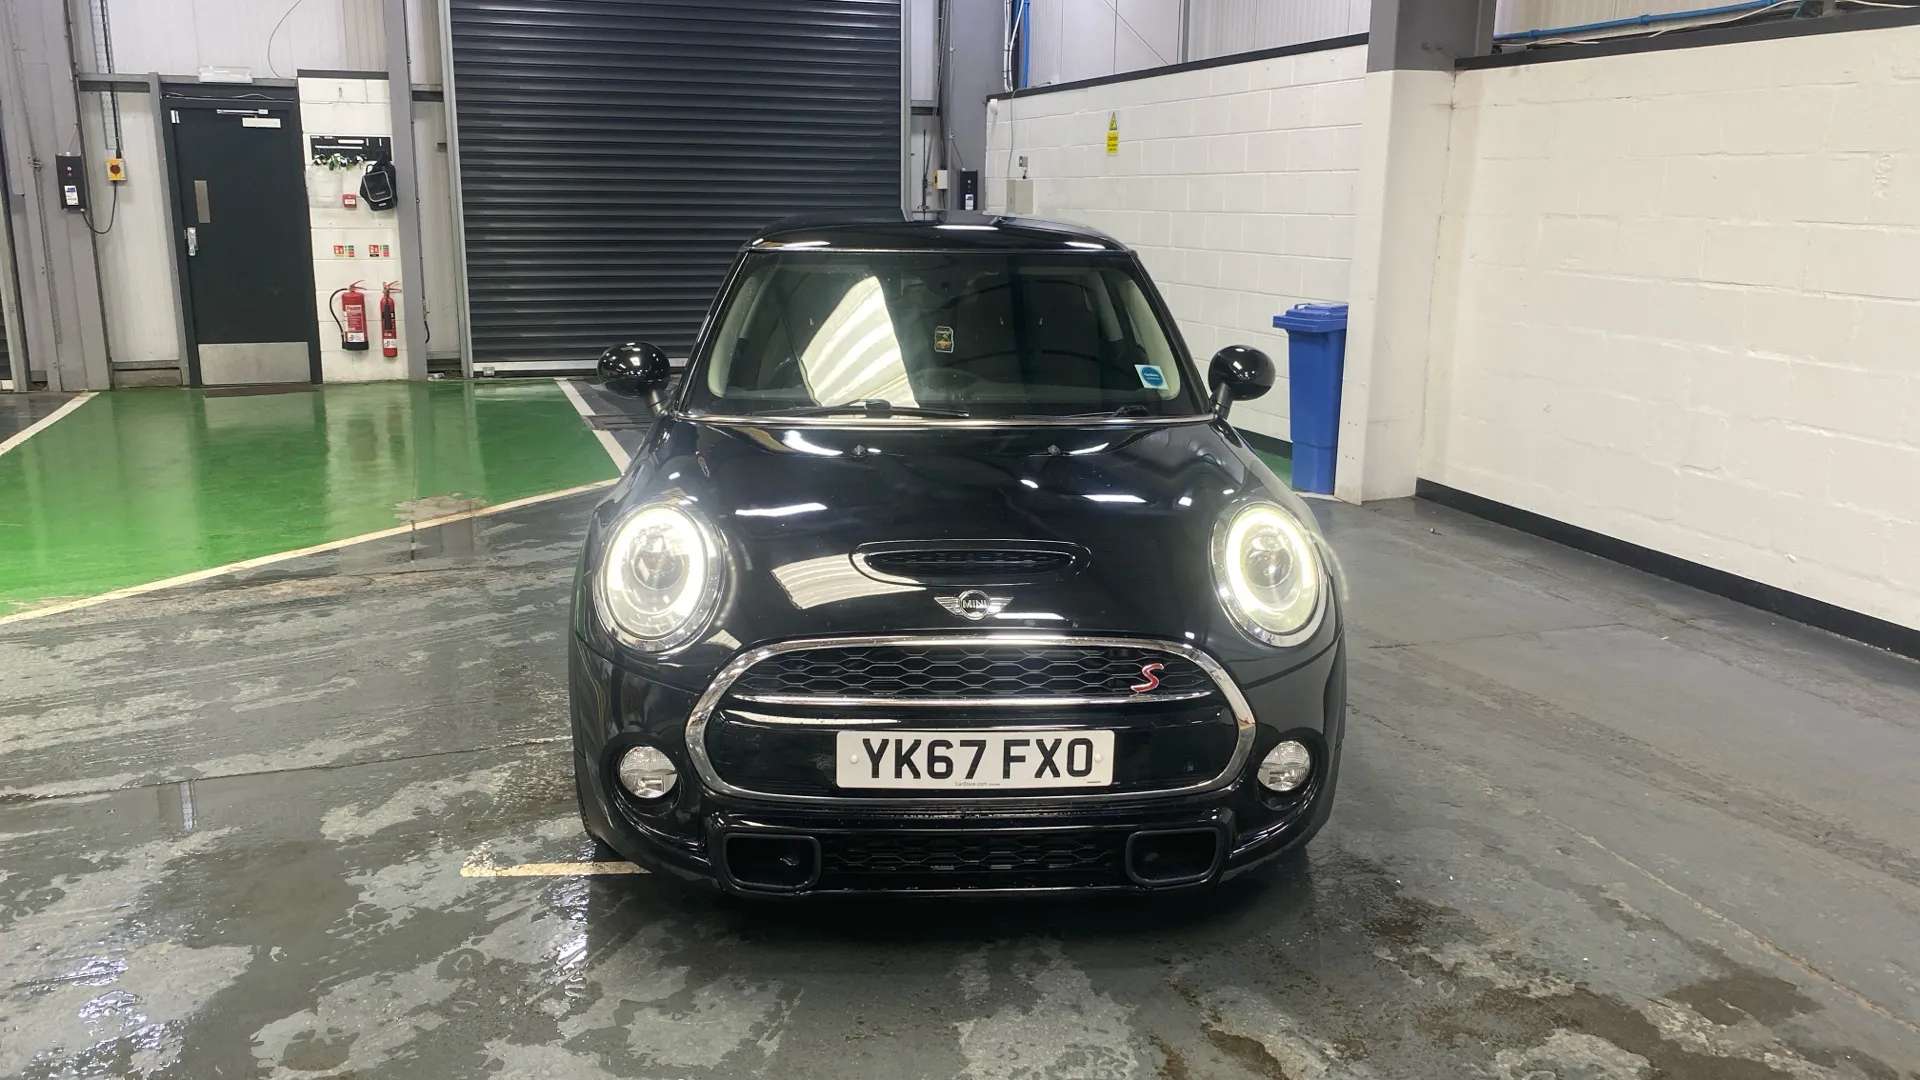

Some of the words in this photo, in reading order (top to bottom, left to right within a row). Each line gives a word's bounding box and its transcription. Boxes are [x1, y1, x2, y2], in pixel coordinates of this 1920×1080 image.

[962, 599, 988, 609] MINI
[1130, 662, 1165, 693] S
[862, 738, 987, 780] YK67
[1002, 737, 1094, 779] FXO
